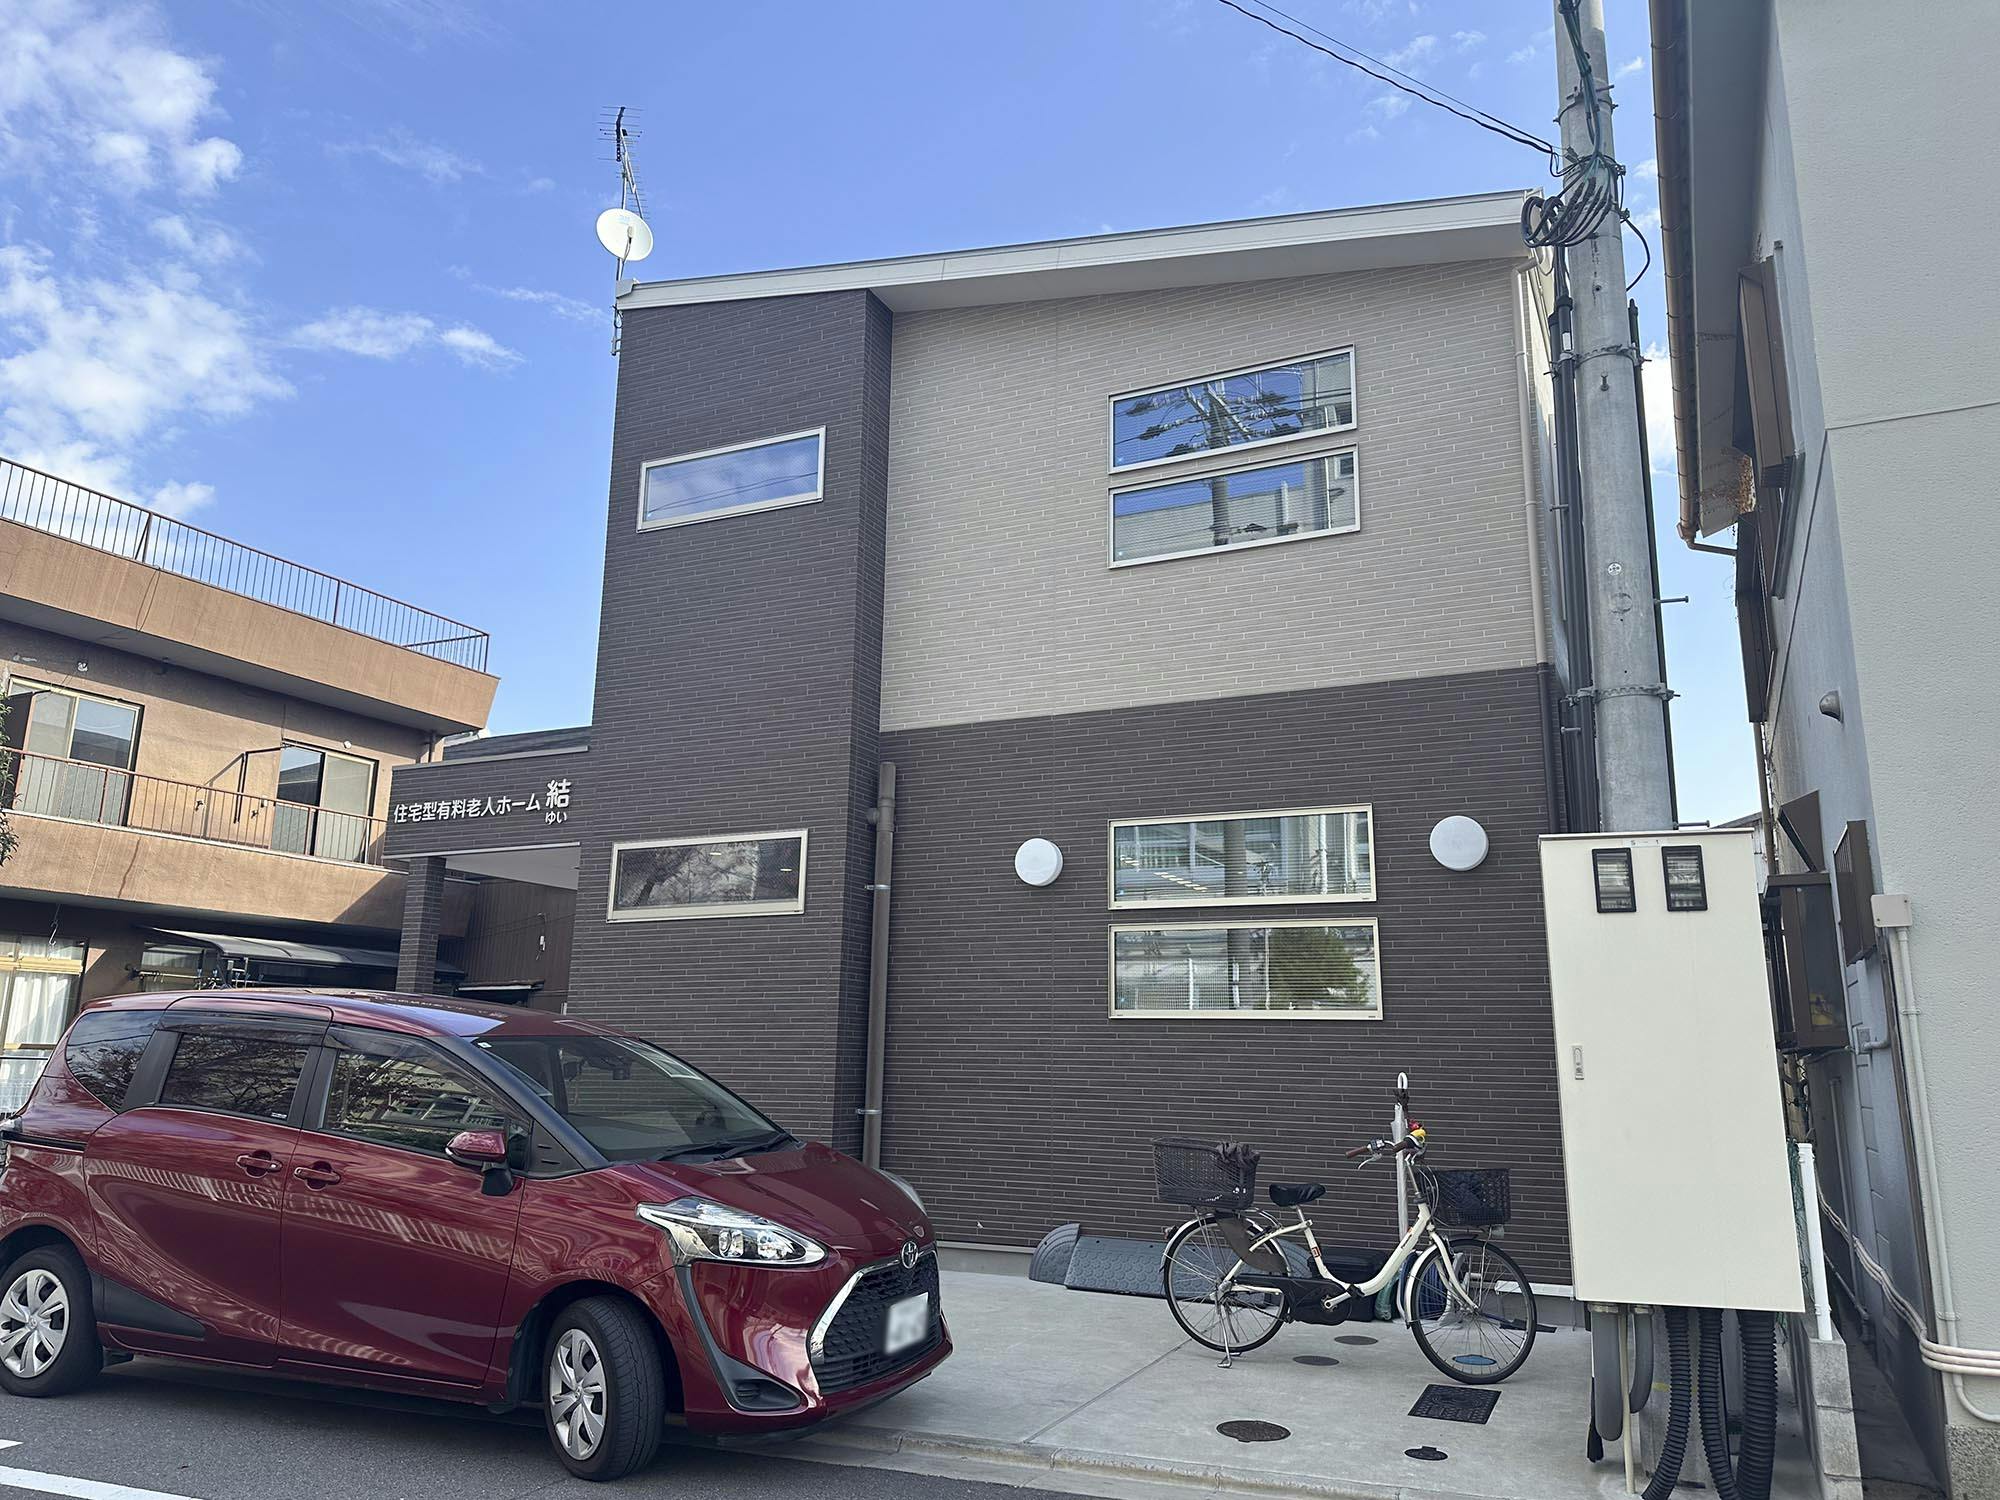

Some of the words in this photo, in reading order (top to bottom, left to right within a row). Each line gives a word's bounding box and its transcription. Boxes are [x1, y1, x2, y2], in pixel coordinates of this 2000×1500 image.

[394, 794, 541, 823] 住宅型有料老人ホーム
[545, 778, 572, 809] 結
[545, 810, 567, 825] ゆい
